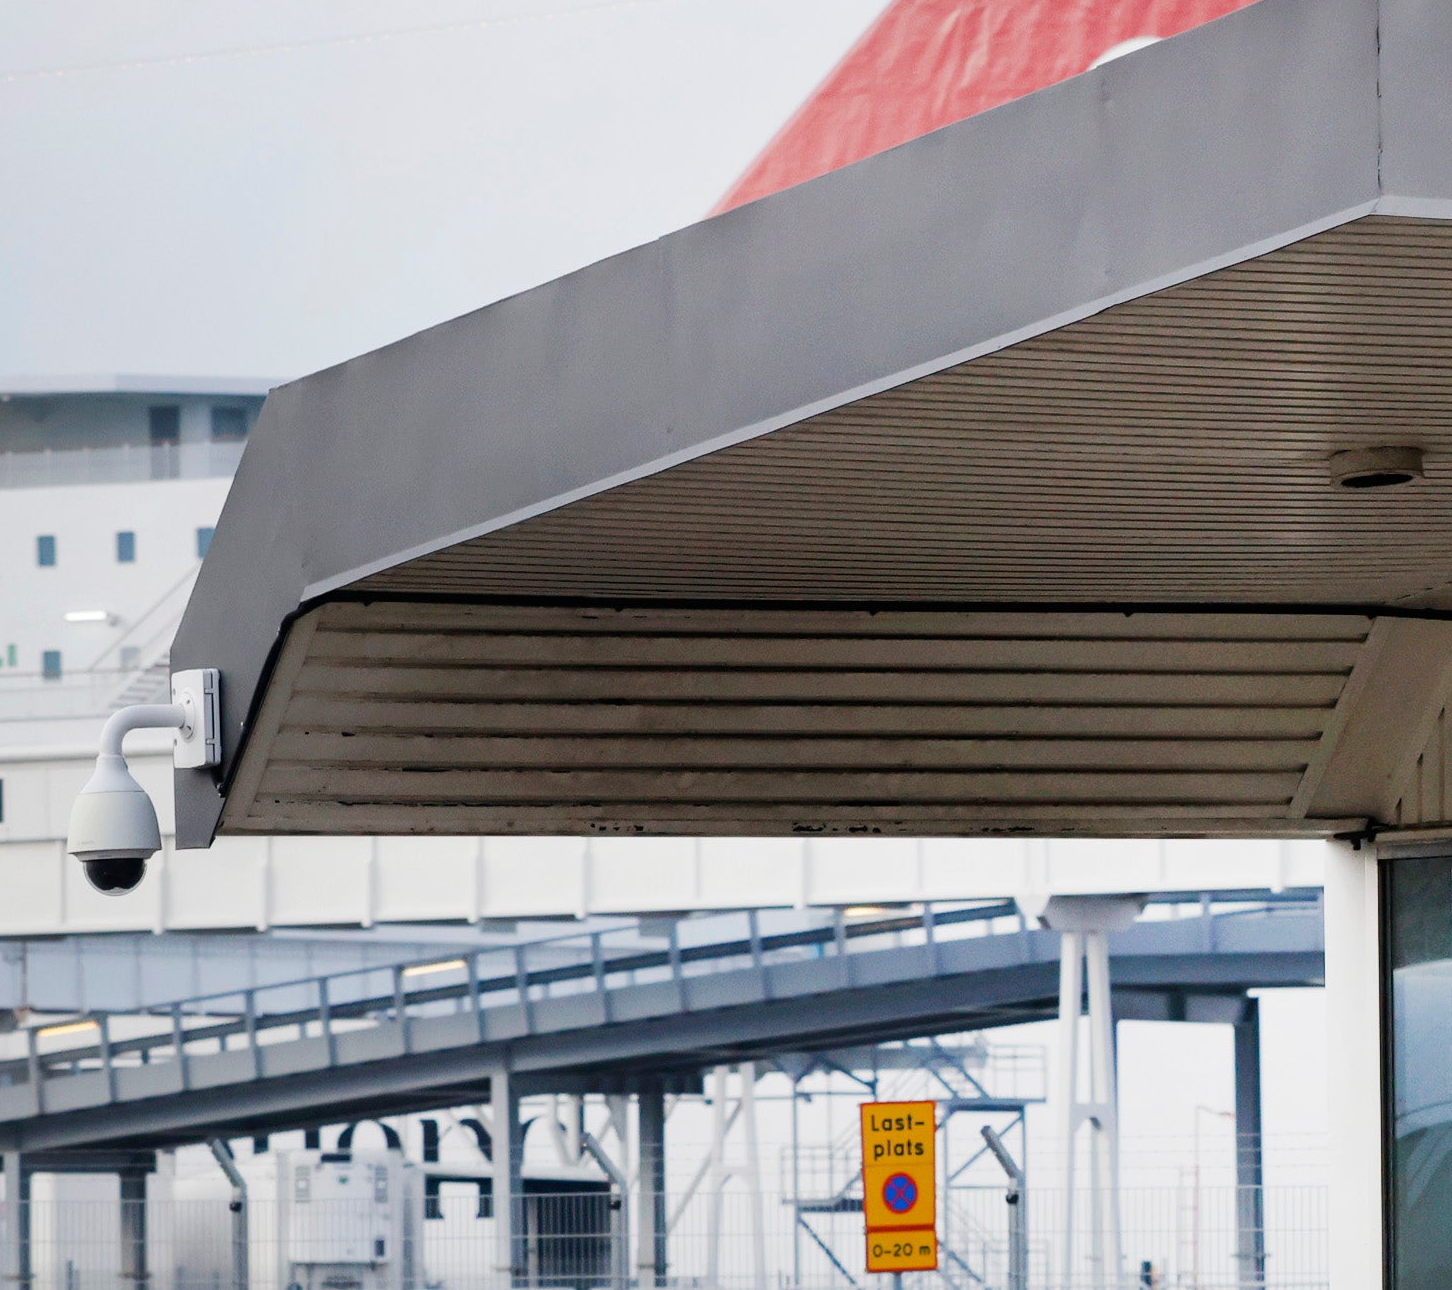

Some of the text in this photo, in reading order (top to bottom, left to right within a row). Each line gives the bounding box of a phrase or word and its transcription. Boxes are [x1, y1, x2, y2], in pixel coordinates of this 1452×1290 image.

[871, 1113, 925, 1132] Last-
[873, 1139, 925, 1161] plats
[872, 1243, 931, 1258] 0-20 m
